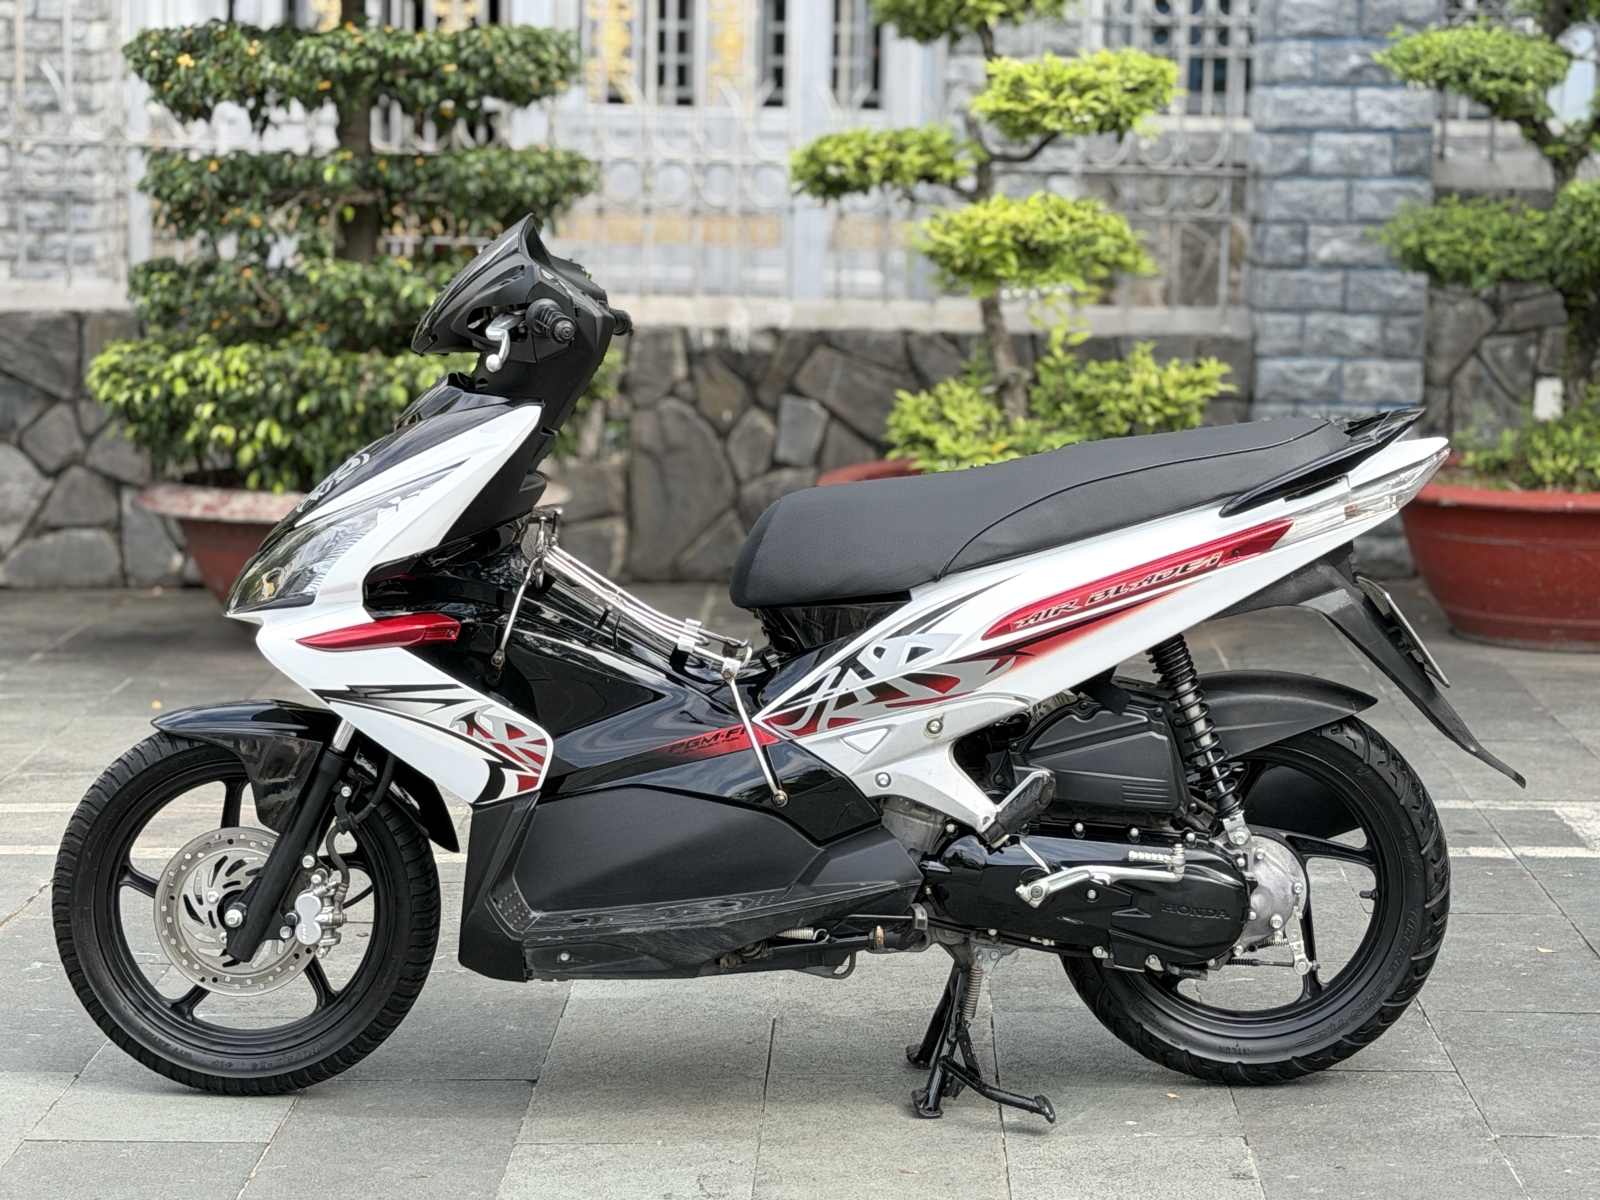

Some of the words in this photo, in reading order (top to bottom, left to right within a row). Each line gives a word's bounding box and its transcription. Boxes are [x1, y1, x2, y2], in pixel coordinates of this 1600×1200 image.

[1013, 598, 1083, 629] AIR
[1161, 902, 1231, 921] HONDA
[1218, 1044, 1250, 1057] NYLON
